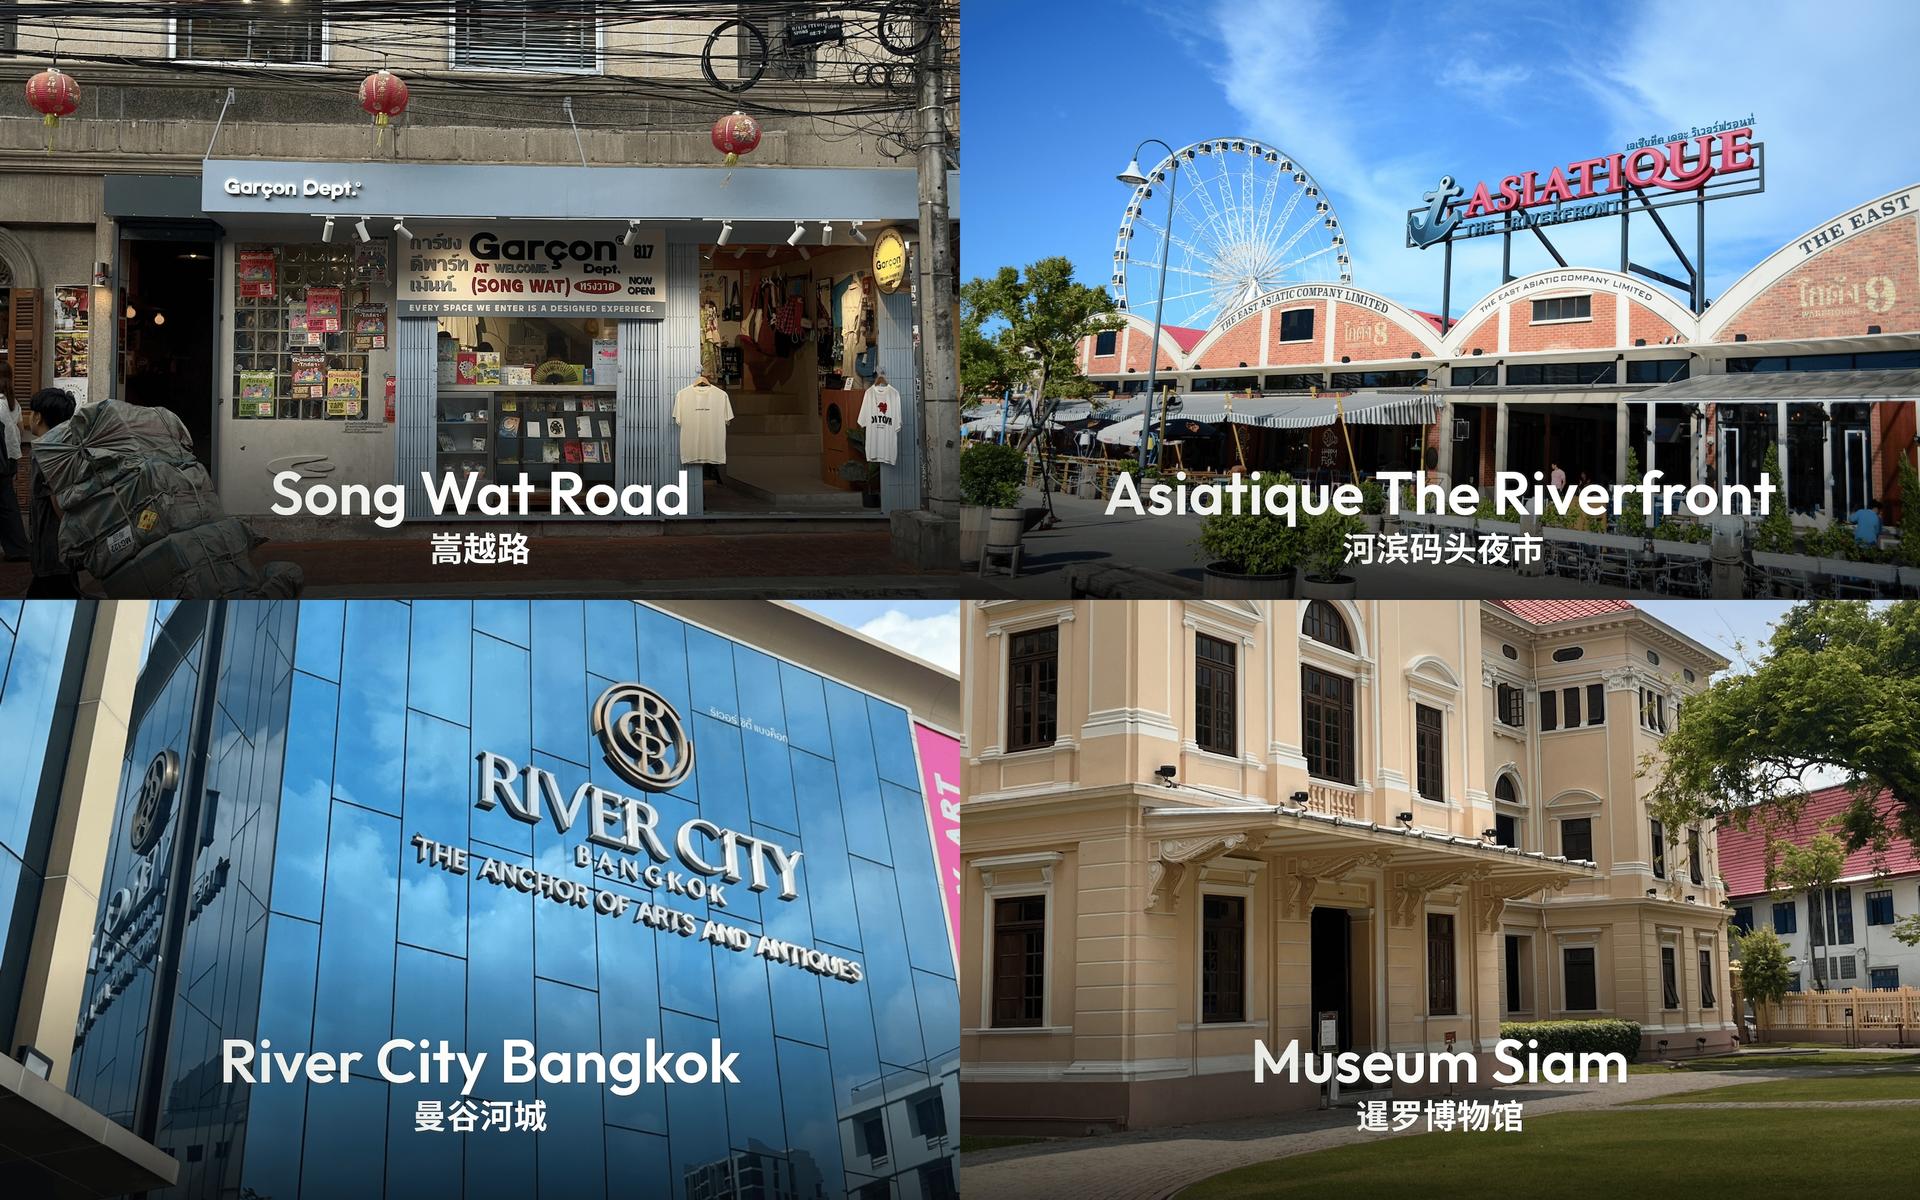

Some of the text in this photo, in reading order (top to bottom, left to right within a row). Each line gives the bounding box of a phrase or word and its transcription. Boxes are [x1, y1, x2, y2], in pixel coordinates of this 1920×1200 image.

[224, 178, 297, 200] Garçon
[1463, 127, 1754, 218] ASIATIQUE
[1464, 199, 1622, 238] THE RIVERFRONT
[1798, 194, 1911, 255] THE EAST
[474, 263, 490, 274] AT
[583, 263, 621, 276] Dept.
[633, 244, 654, 259] 817
[471, 277, 571, 297] (SONG WAT)
[629, 277, 653, 285] NOW
[1480, 274, 1653, 313] THE EAST ASIATIC COMPANY LIMITED
[1865, 276, 1896, 313] 9
[409, 304, 440, 312] EVERY
[443, 304, 473, 312] SPACE
[476, 304, 491, 312] WE
[494, 304, 524, 312] ENTER
[528, 304, 537, 312] IS
[550, 304, 598, 312] DESIGNED
[1220, 287, 1389, 332] THE EAST ASIATIC COMPANY LIMITED
[1374, 321, 1388, 347] 8
[474, 750, 804, 902] RIVER CITY
[574, 843, 728, 907] BANGKOK
[410, 832, 864, 984] THE ANCHOR OF ARTS AND ANTIQUES
